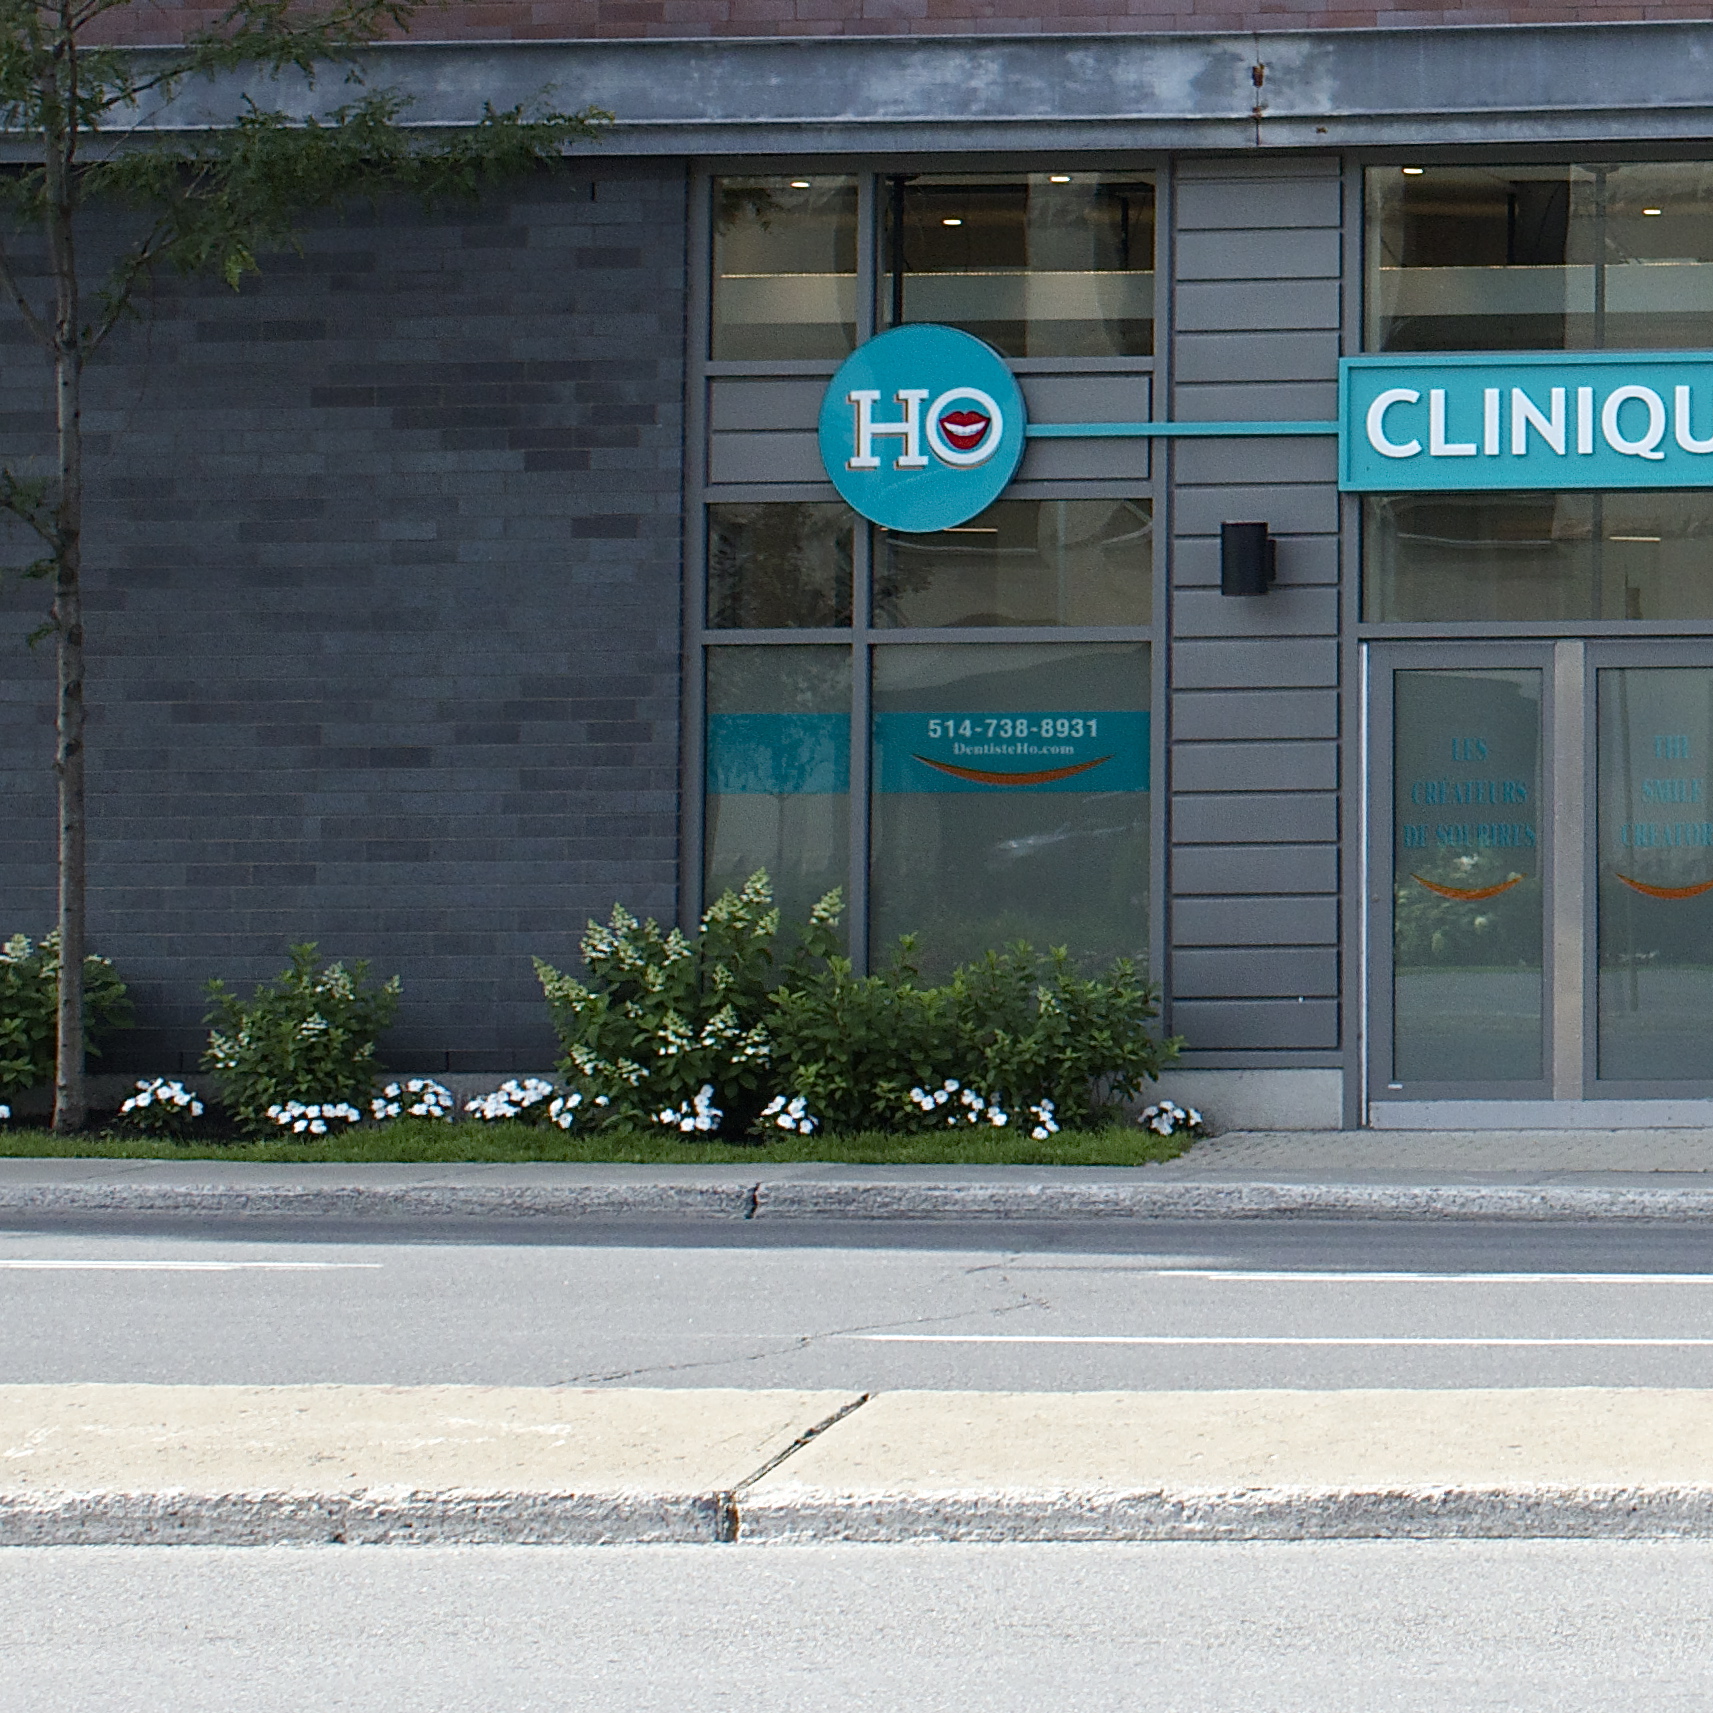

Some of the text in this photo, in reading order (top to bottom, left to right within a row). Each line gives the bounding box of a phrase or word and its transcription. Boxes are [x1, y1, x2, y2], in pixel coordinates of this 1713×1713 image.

[847, 387, 1003, 470] HO
[928, 717, 1098, 739] 514-738-8931
[953, 741, 1075, 756] DentisteHo.com
